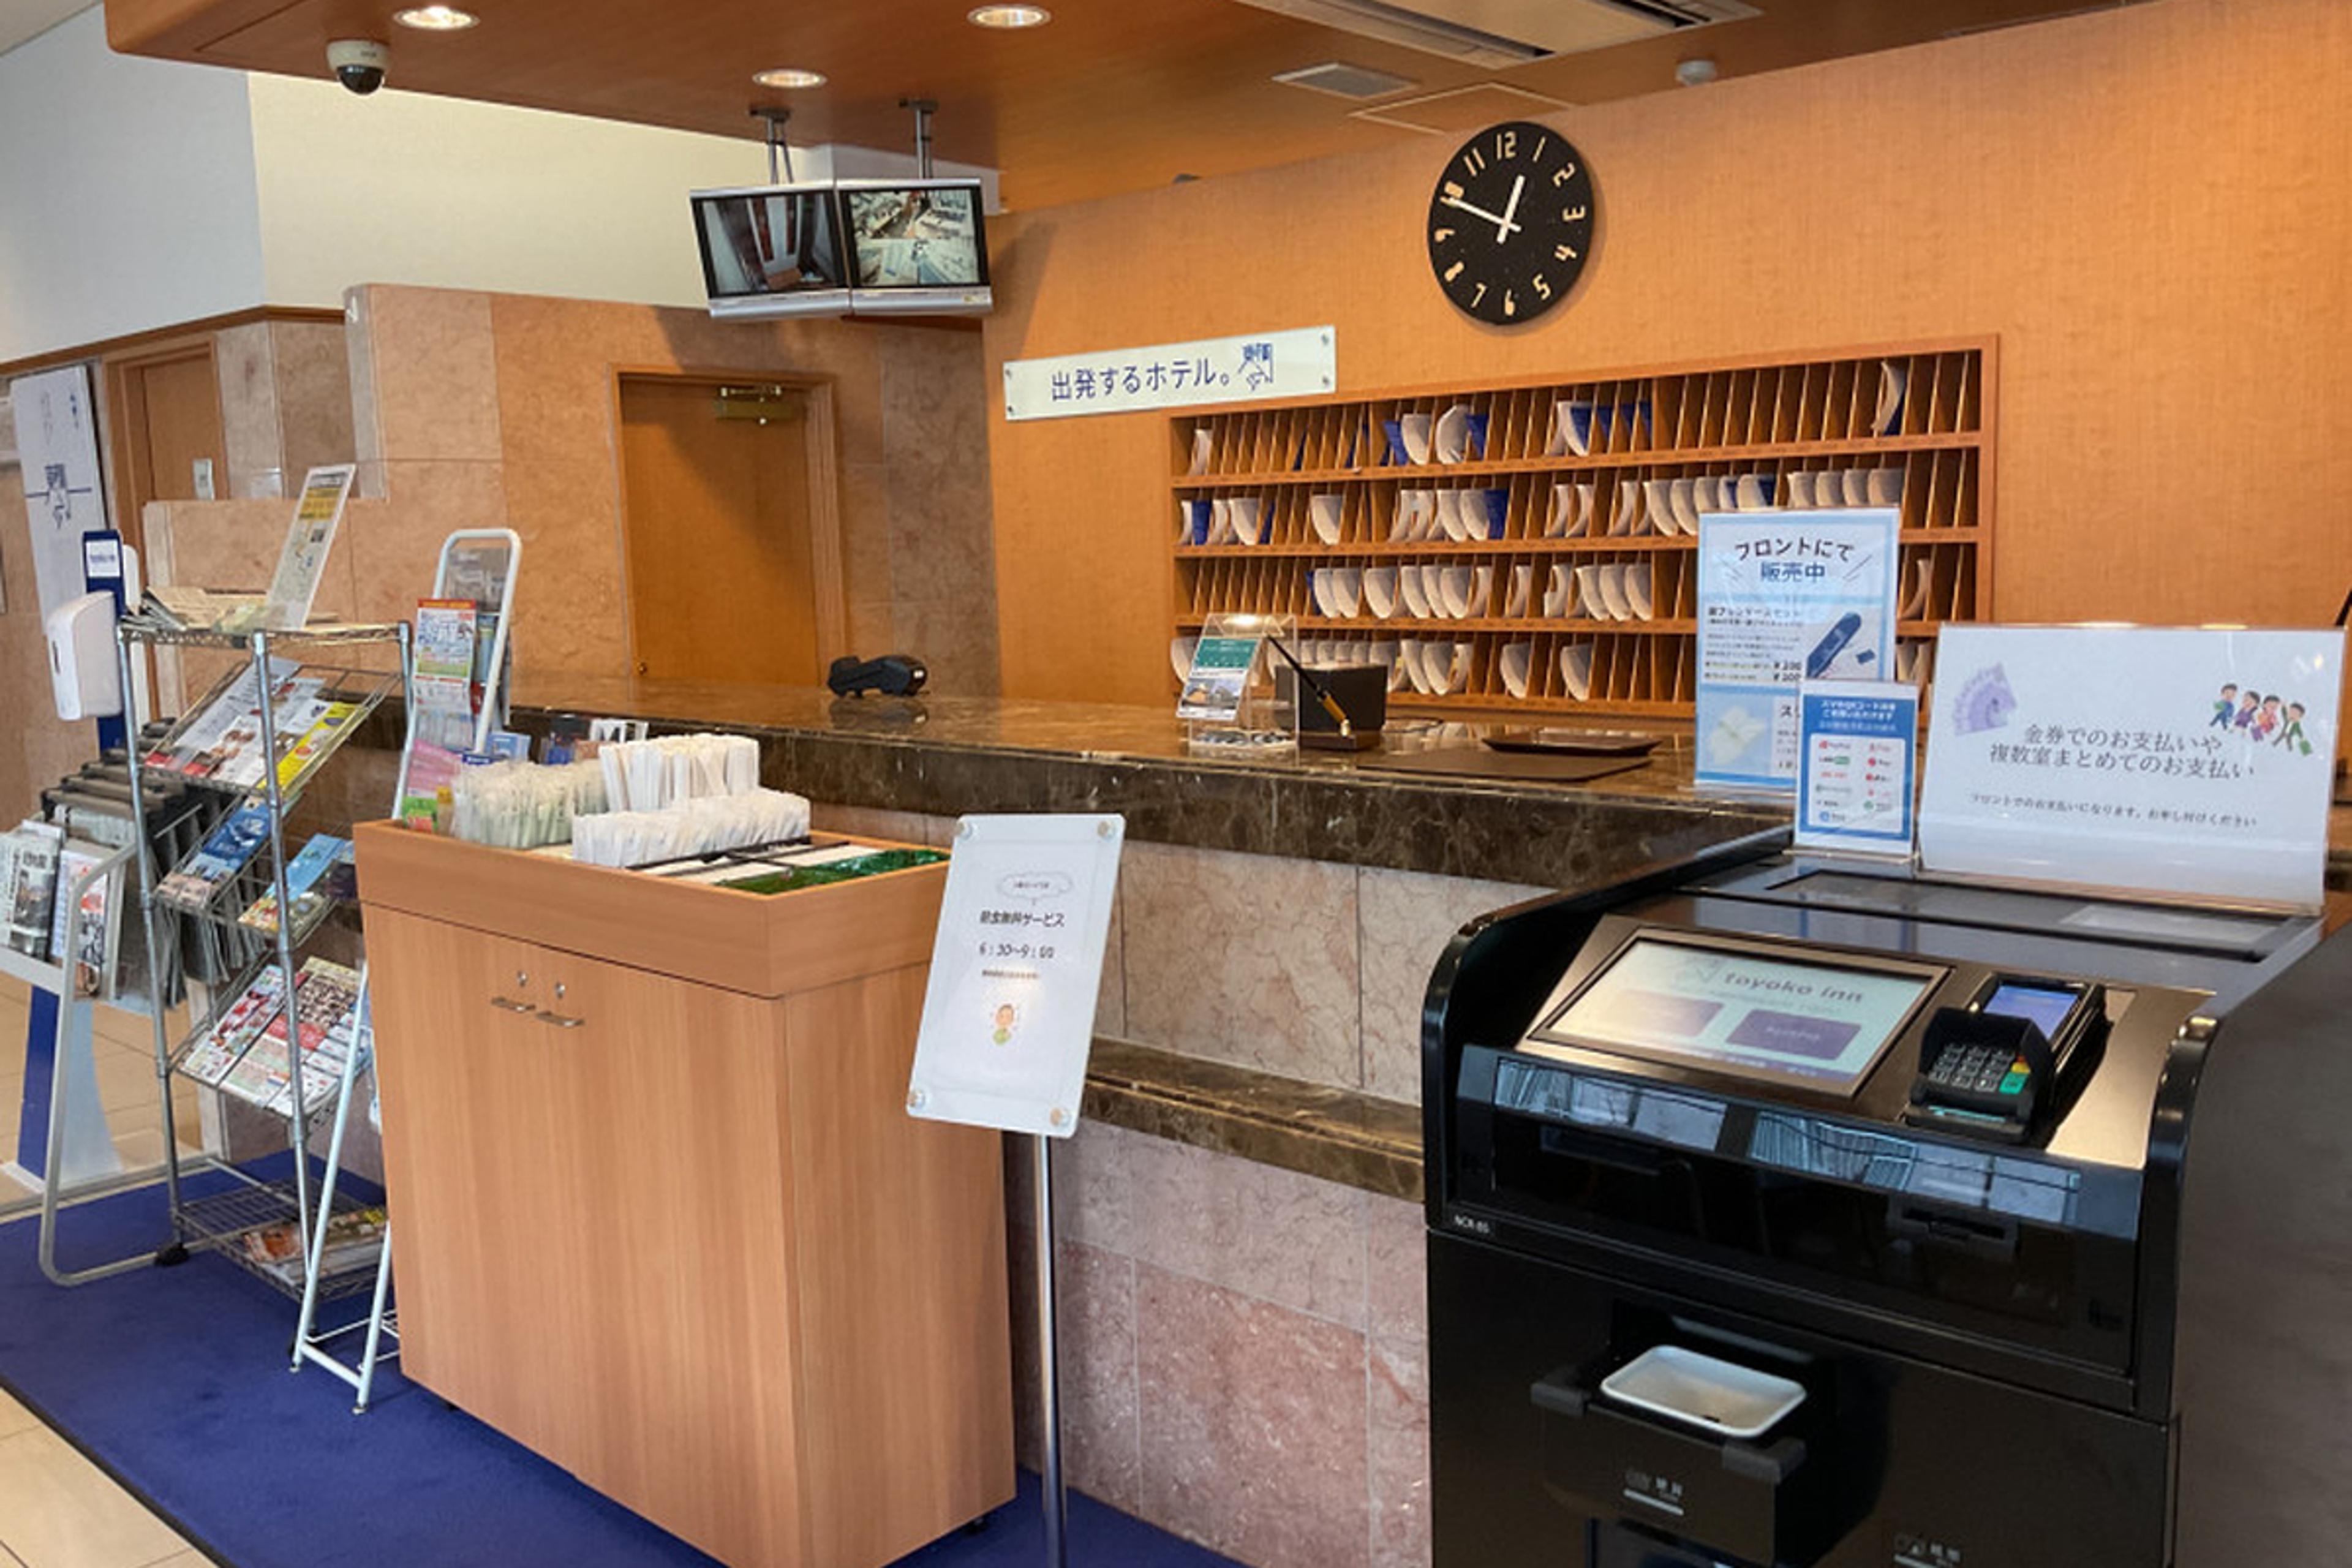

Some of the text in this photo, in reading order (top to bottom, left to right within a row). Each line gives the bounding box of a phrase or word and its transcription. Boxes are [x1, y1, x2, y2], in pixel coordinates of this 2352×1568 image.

[1496, 131, 1516, 160] 12
[1532, 136, 1546, 162] 1
[1553, 162, 1575, 187] 2
[1562, 205, 1586, 221] 3
[1555, 244, 1577, 261] 4
[1471, 282, 1487, 308] 7
[1532, 273, 1551, 300] 5
[1504, 288, 1515, 316] 6
[1052, 358, 1229, 401] 出発するホテル。
[1735, 536, 1855, 562] フロントにて
[1760, 562, 1826, 582] 販売中
[2024, 723, 2223, 755] 金券でのお支払いや
[1990, 743, 2255, 779] 複数室まとめてのお支払い
[1724, 971, 1863, 1003] toyoko inn
